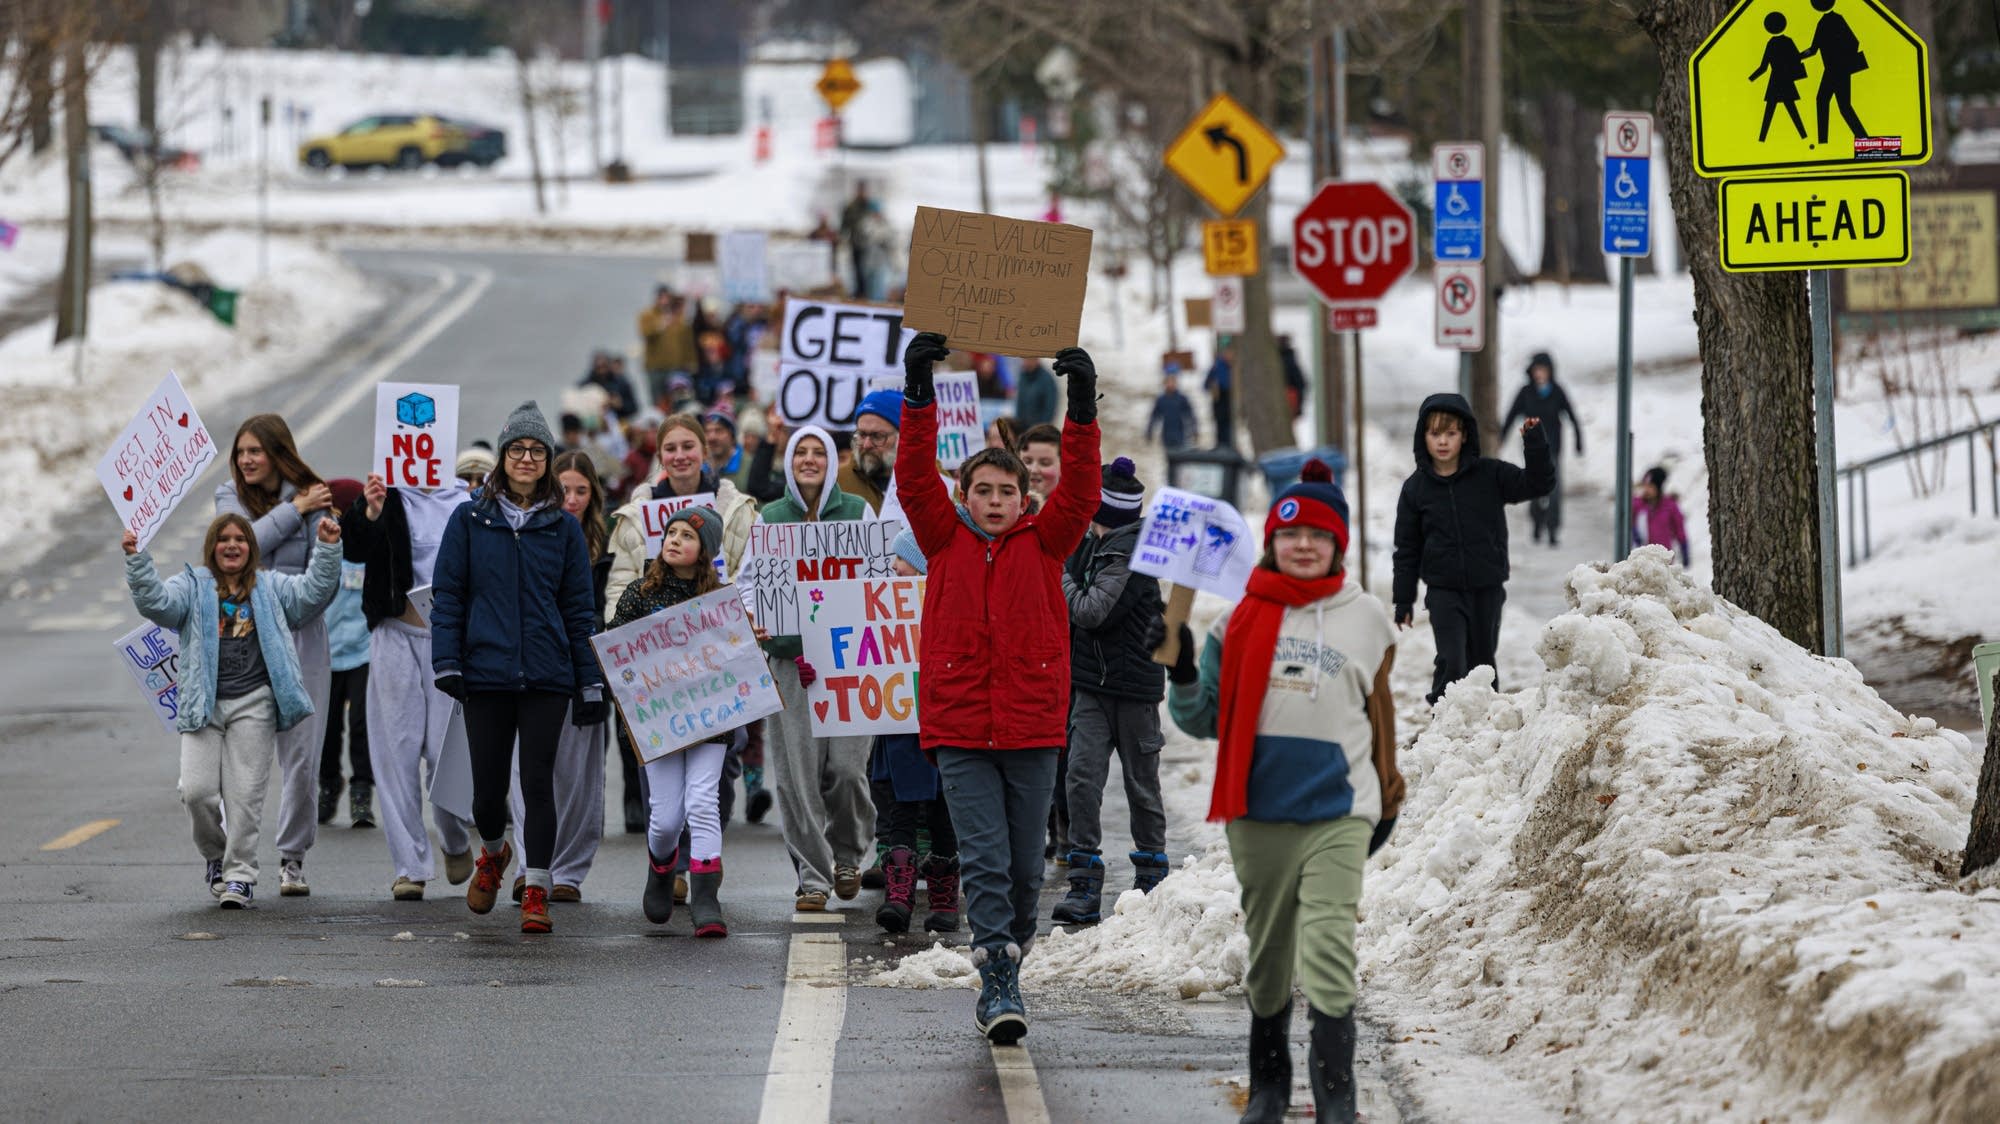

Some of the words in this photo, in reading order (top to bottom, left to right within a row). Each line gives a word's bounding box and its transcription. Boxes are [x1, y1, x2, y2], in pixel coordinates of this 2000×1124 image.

[922, 210, 983, 246] WE
[993, 221, 1067, 254] VALUE
[1213, 230, 1248, 255] 15
[1300, 217, 1407, 267] STOP
[1745, 198, 1886, 244] AHEAD
[921, 247, 977, 278] OUR
[791, 306, 903, 365] GET
[781, 369, 872, 425] OU
[115, 432, 146, 480] REST
[148, 397, 174, 438] IN
[392, 433, 434, 459] NO
[134, 434, 175, 491] POWER
[156, 454, 186, 497] NICOLE
[385, 457, 442, 487] ICE
[642, 499, 693, 537] LO
[750, 524, 799, 559] FIGHT
[800, 520, 896, 558] IGNORANCE
[796, 556, 864, 582] NOT
[126, 626, 173, 670] WE
[607, 598, 743, 667] IMMIGRANTS
